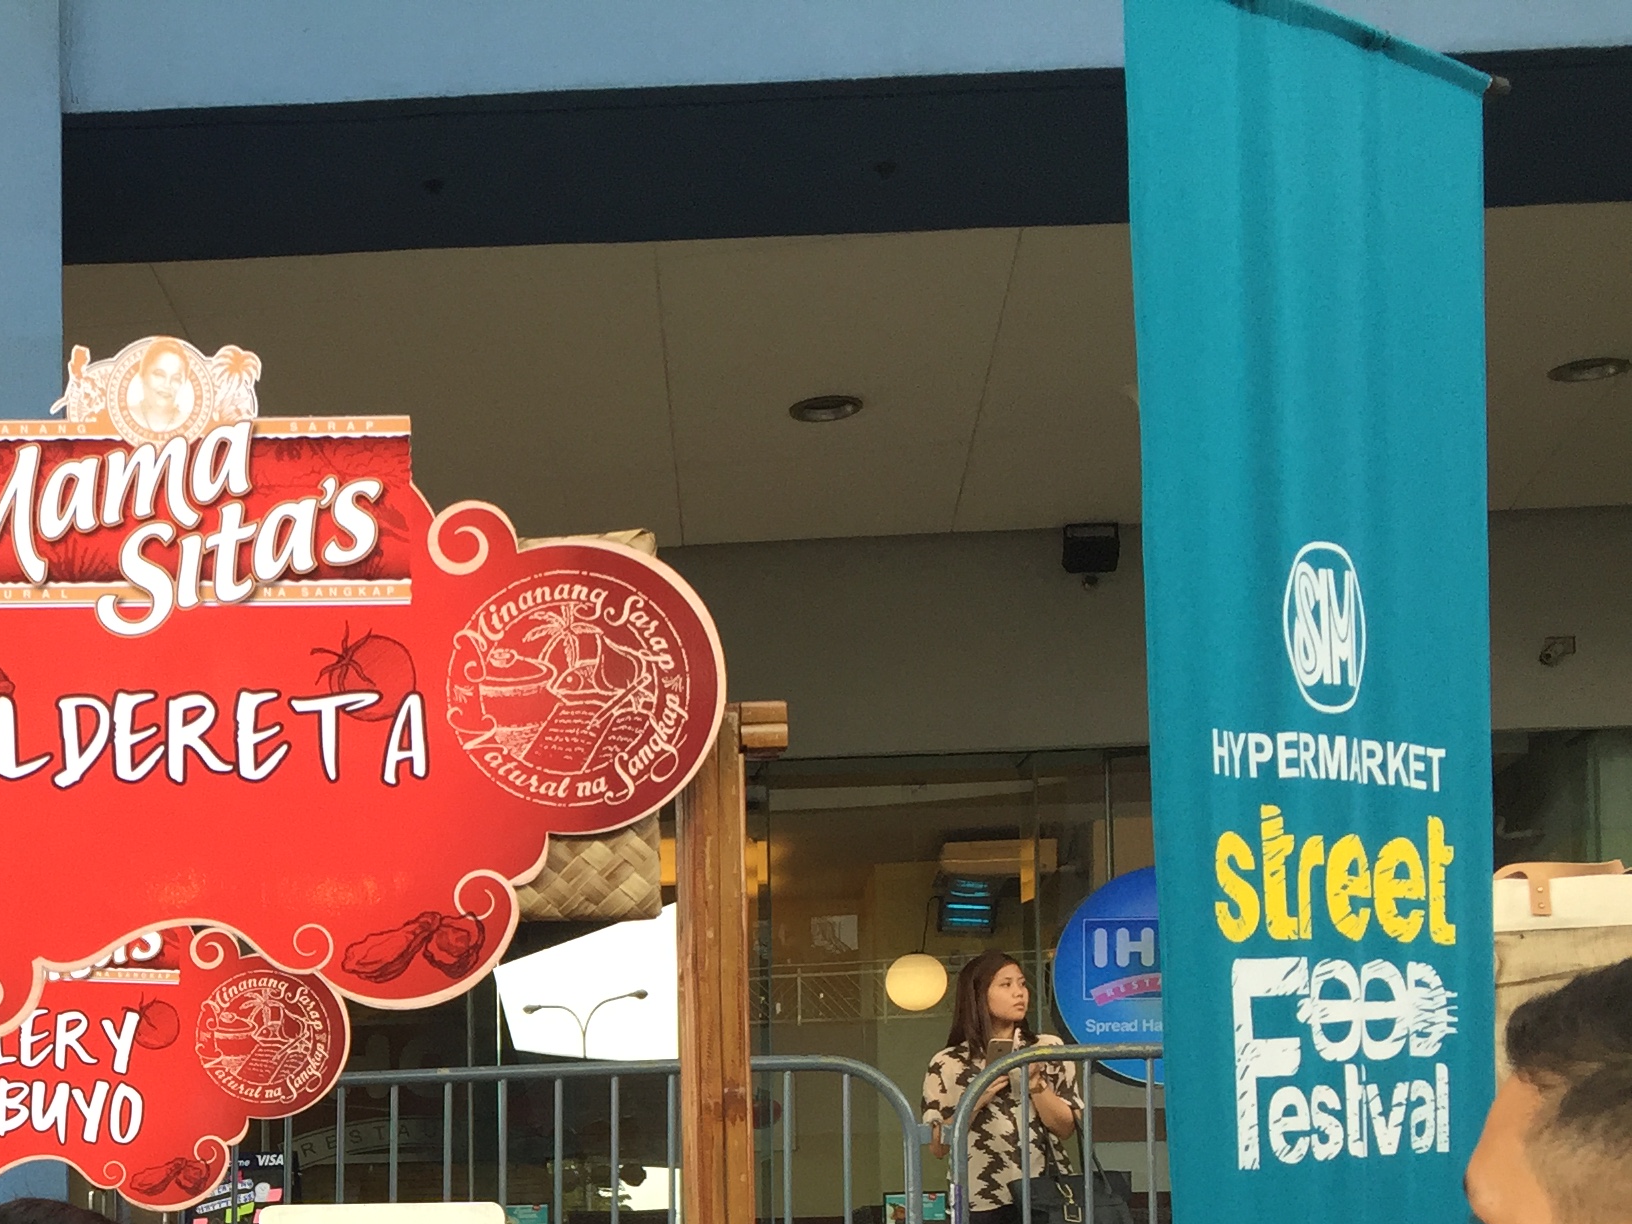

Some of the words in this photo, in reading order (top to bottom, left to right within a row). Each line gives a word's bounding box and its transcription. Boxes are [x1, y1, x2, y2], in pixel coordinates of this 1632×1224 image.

[288, 421, 377, 433] SARAP
[97, 476, 383, 636] Sita's
[300, 585, 396, 597] SANGKAP
[453, 584, 608, 682] Minanang
[603, 594, 675, 671] Sarap
[447, 707, 570, 799] Natural
[576, 776, 609, 797] na
[604, 693, 689, 805] Sangkap
[1212, 728, 1446, 792] HYPERMARKET
[1214, 804, 1457, 945] street
[201, 977, 289, 1031] Minanang
[285, 986, 324, 1031] Sarap
[1085, 1019, 1138, 1035] Spread
[195, 1043, 262, 1098] Natural
[264, 1087, 282, 1098] na
[256, 1154, 284, 1166] VISA
